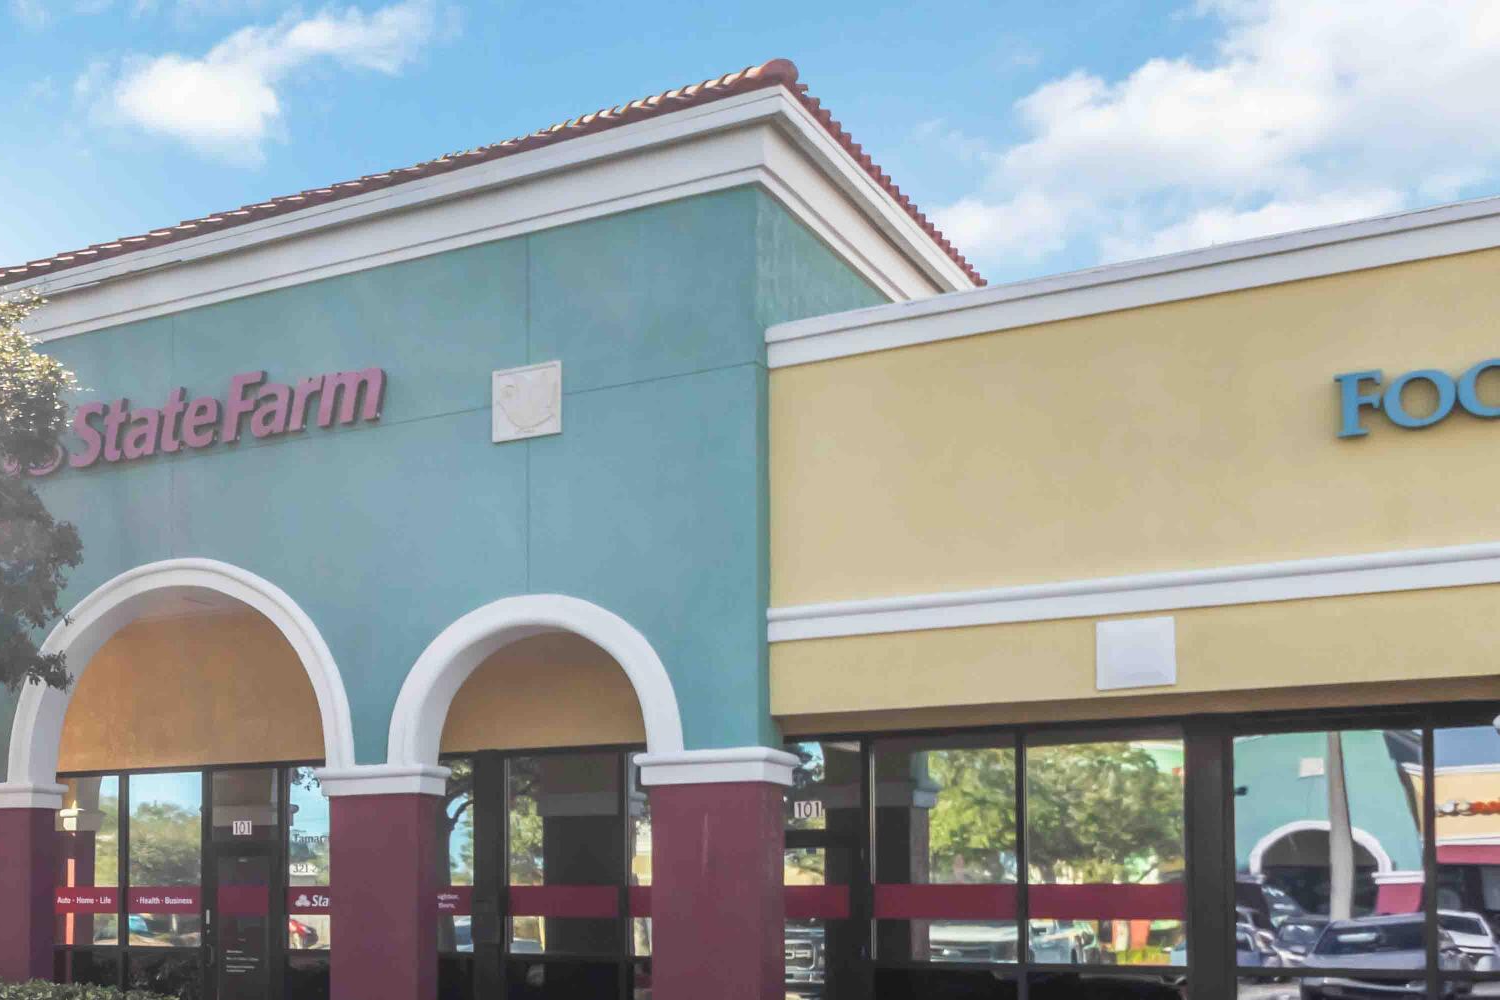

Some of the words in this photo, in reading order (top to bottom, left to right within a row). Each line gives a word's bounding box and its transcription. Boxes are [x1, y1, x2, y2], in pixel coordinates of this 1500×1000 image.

[797, 802, 820, 818] 101
[235, 821, 251, 834] 101
[57, 896, 71, 904] Auto
[76, 896, 94, 904] Home
[100, 896, 111, 904] Life
[139, 896, 160, 905] Health
[164, 896, 192, 905] Business
